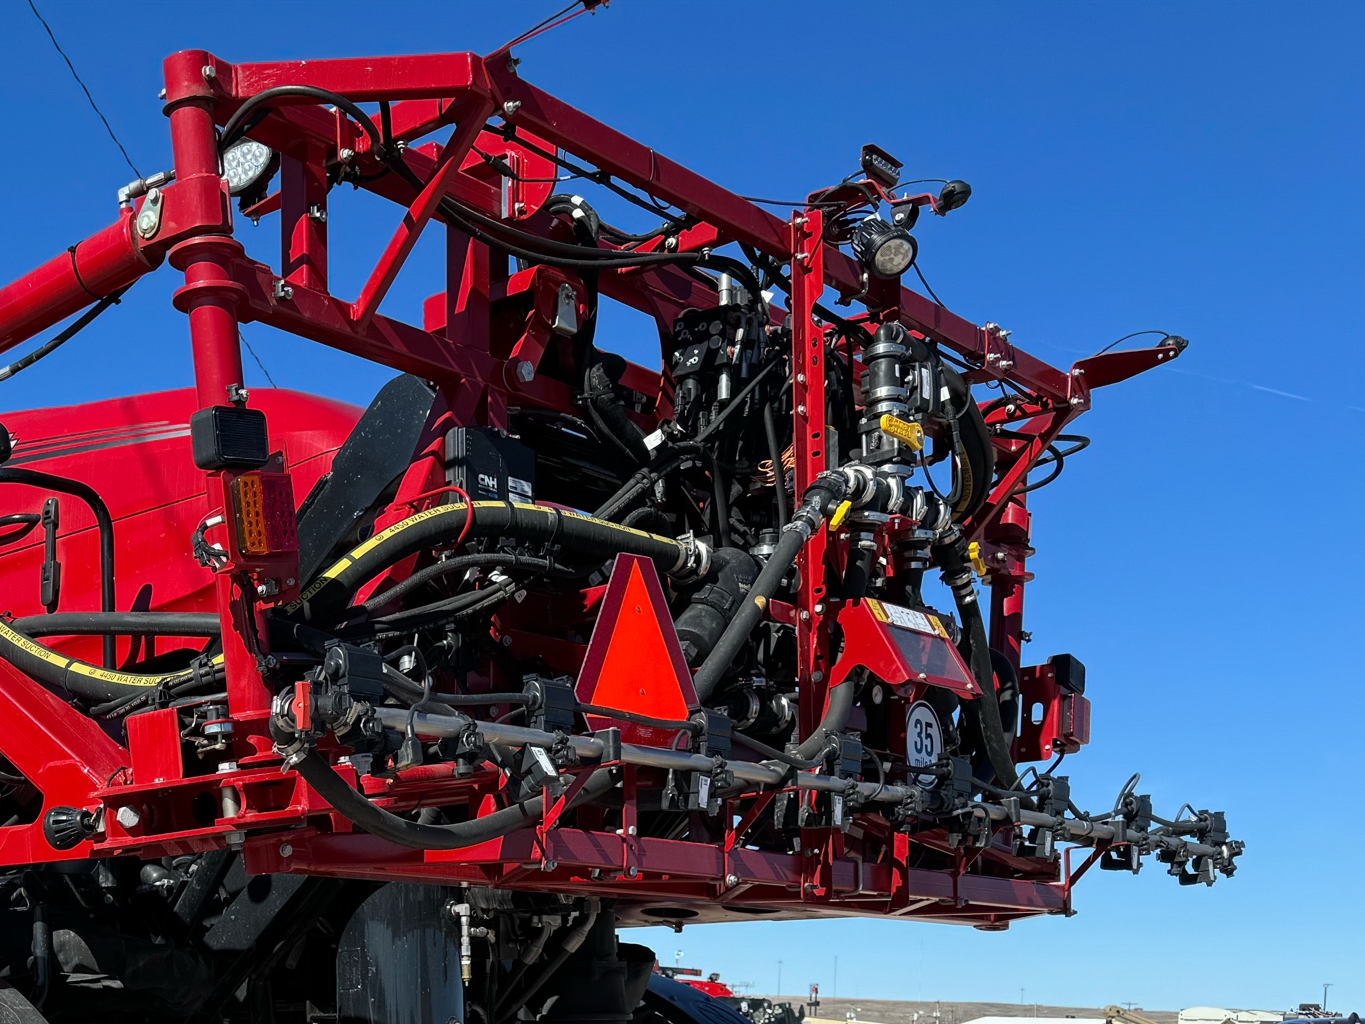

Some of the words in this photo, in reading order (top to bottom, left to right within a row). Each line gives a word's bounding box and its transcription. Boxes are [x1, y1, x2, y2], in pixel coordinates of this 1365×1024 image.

[478, 473, 498, 489] CNH
[389, 521, 409, 533] 4450
[409, 509, 440, 522] WATER
[441, 501, 482, 511] SUCTN
[289, 576, 329, 610] SUCTION
[20, 640, 52, 660] SUCTION
[99, 671, 116, 681] 4450
[116, 676, 143, 685] WATER
[914, 718, 934, 757] 35
